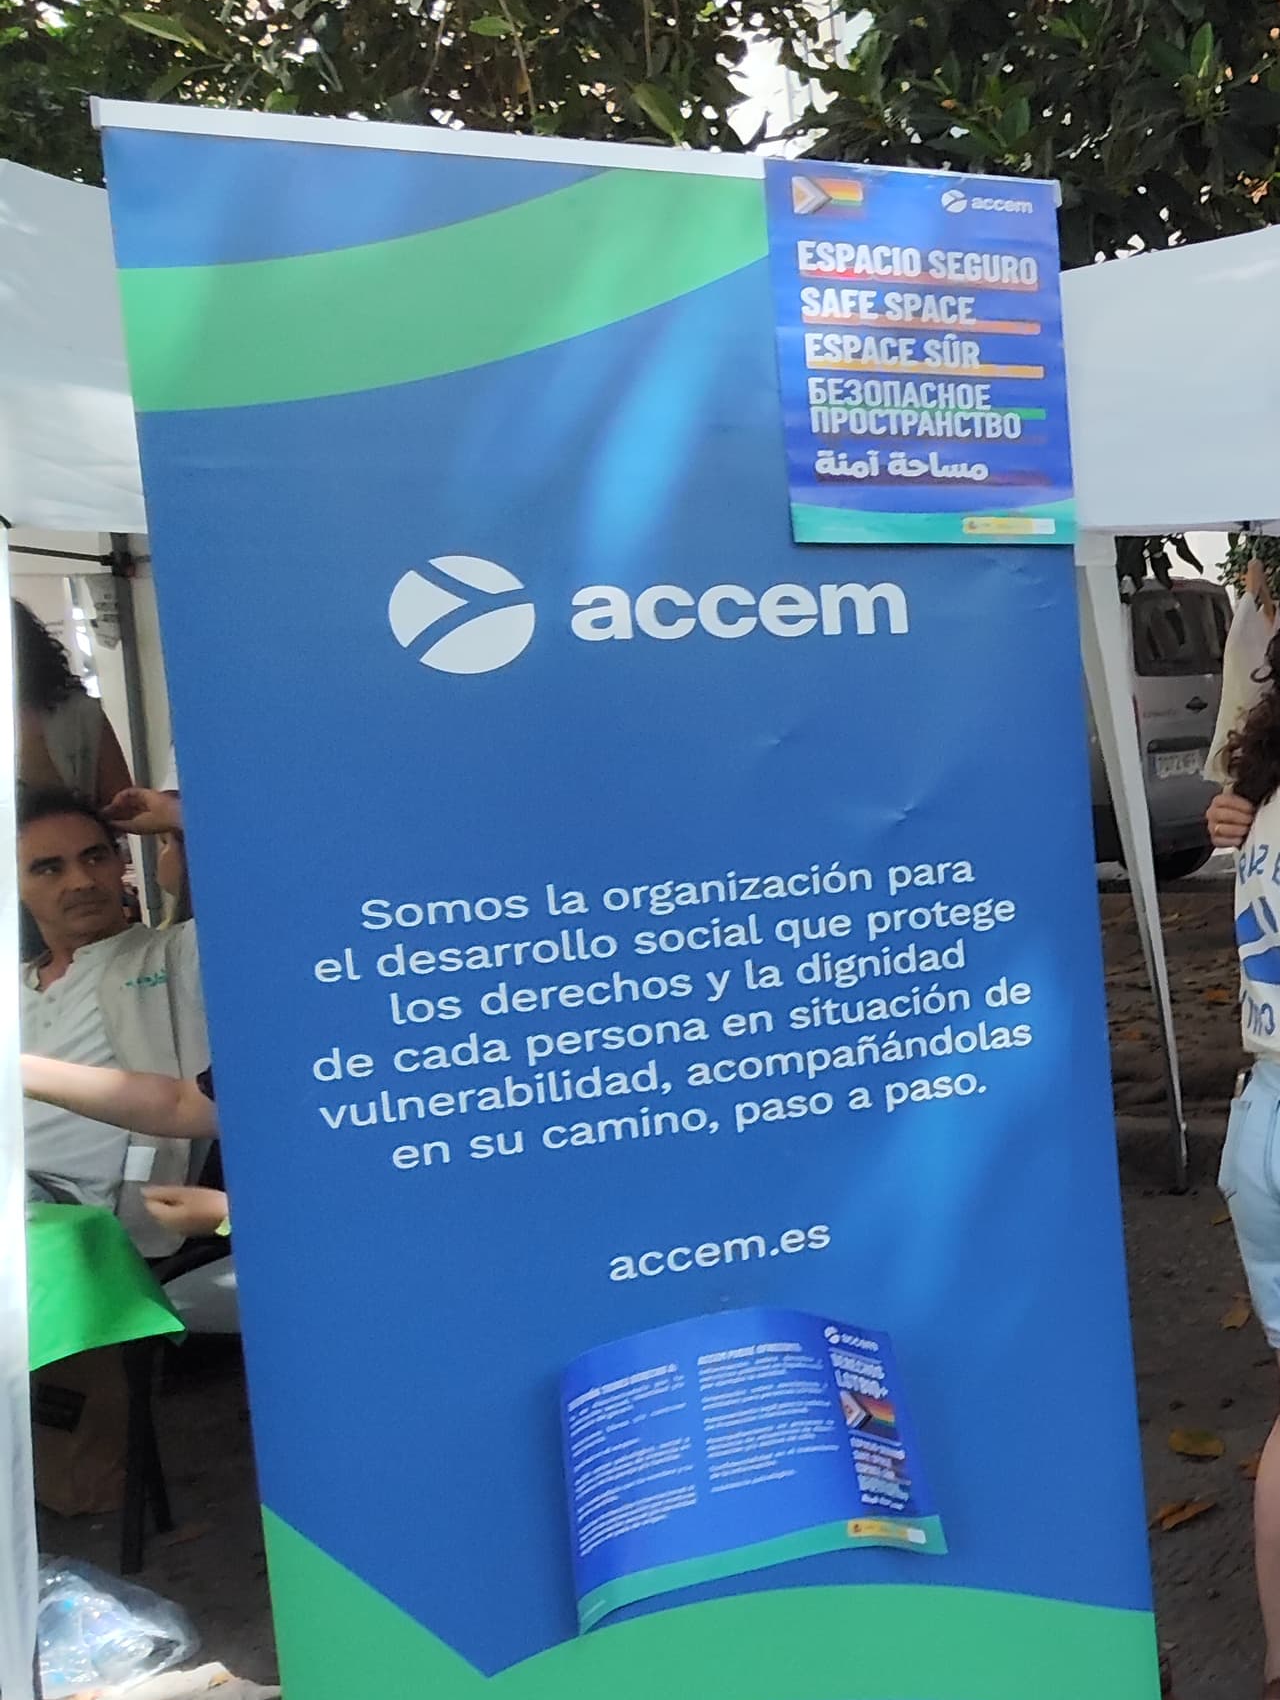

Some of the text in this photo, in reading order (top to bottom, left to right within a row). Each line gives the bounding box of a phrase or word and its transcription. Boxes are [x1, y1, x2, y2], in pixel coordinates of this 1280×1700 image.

[971, 196, 1033, 214] accem
[797, 240, 1038, 285] ESPACIO SEGURO
[800, 288, 975, 325] SAFE SPACE
[804, 333, 917, 367] ESPACE
[808, 376, 991, 411] БЕЗОПАСНОЕ
[810, 407, 1022, 439] ПРОСТРАНСТВО
[887, 450, 989, 480] مساحة
[571, 581, 908, 641] accem
[361, 858, 974, 931] Somos la organización para
[314, 897, 1015, 983] el desarrollo social que protege
[391, 939, 966, 1025] los derechos y la dignidad
[312, 977, 1032, 1082] de cada persona en situación de
[319, 1020, 1032, 1130] vulnerabilidad, acompañándolas
[391, 1069, 987, 1170] en su camino, paso a paso.
[608, 1222, 830, 1283] accem.es
